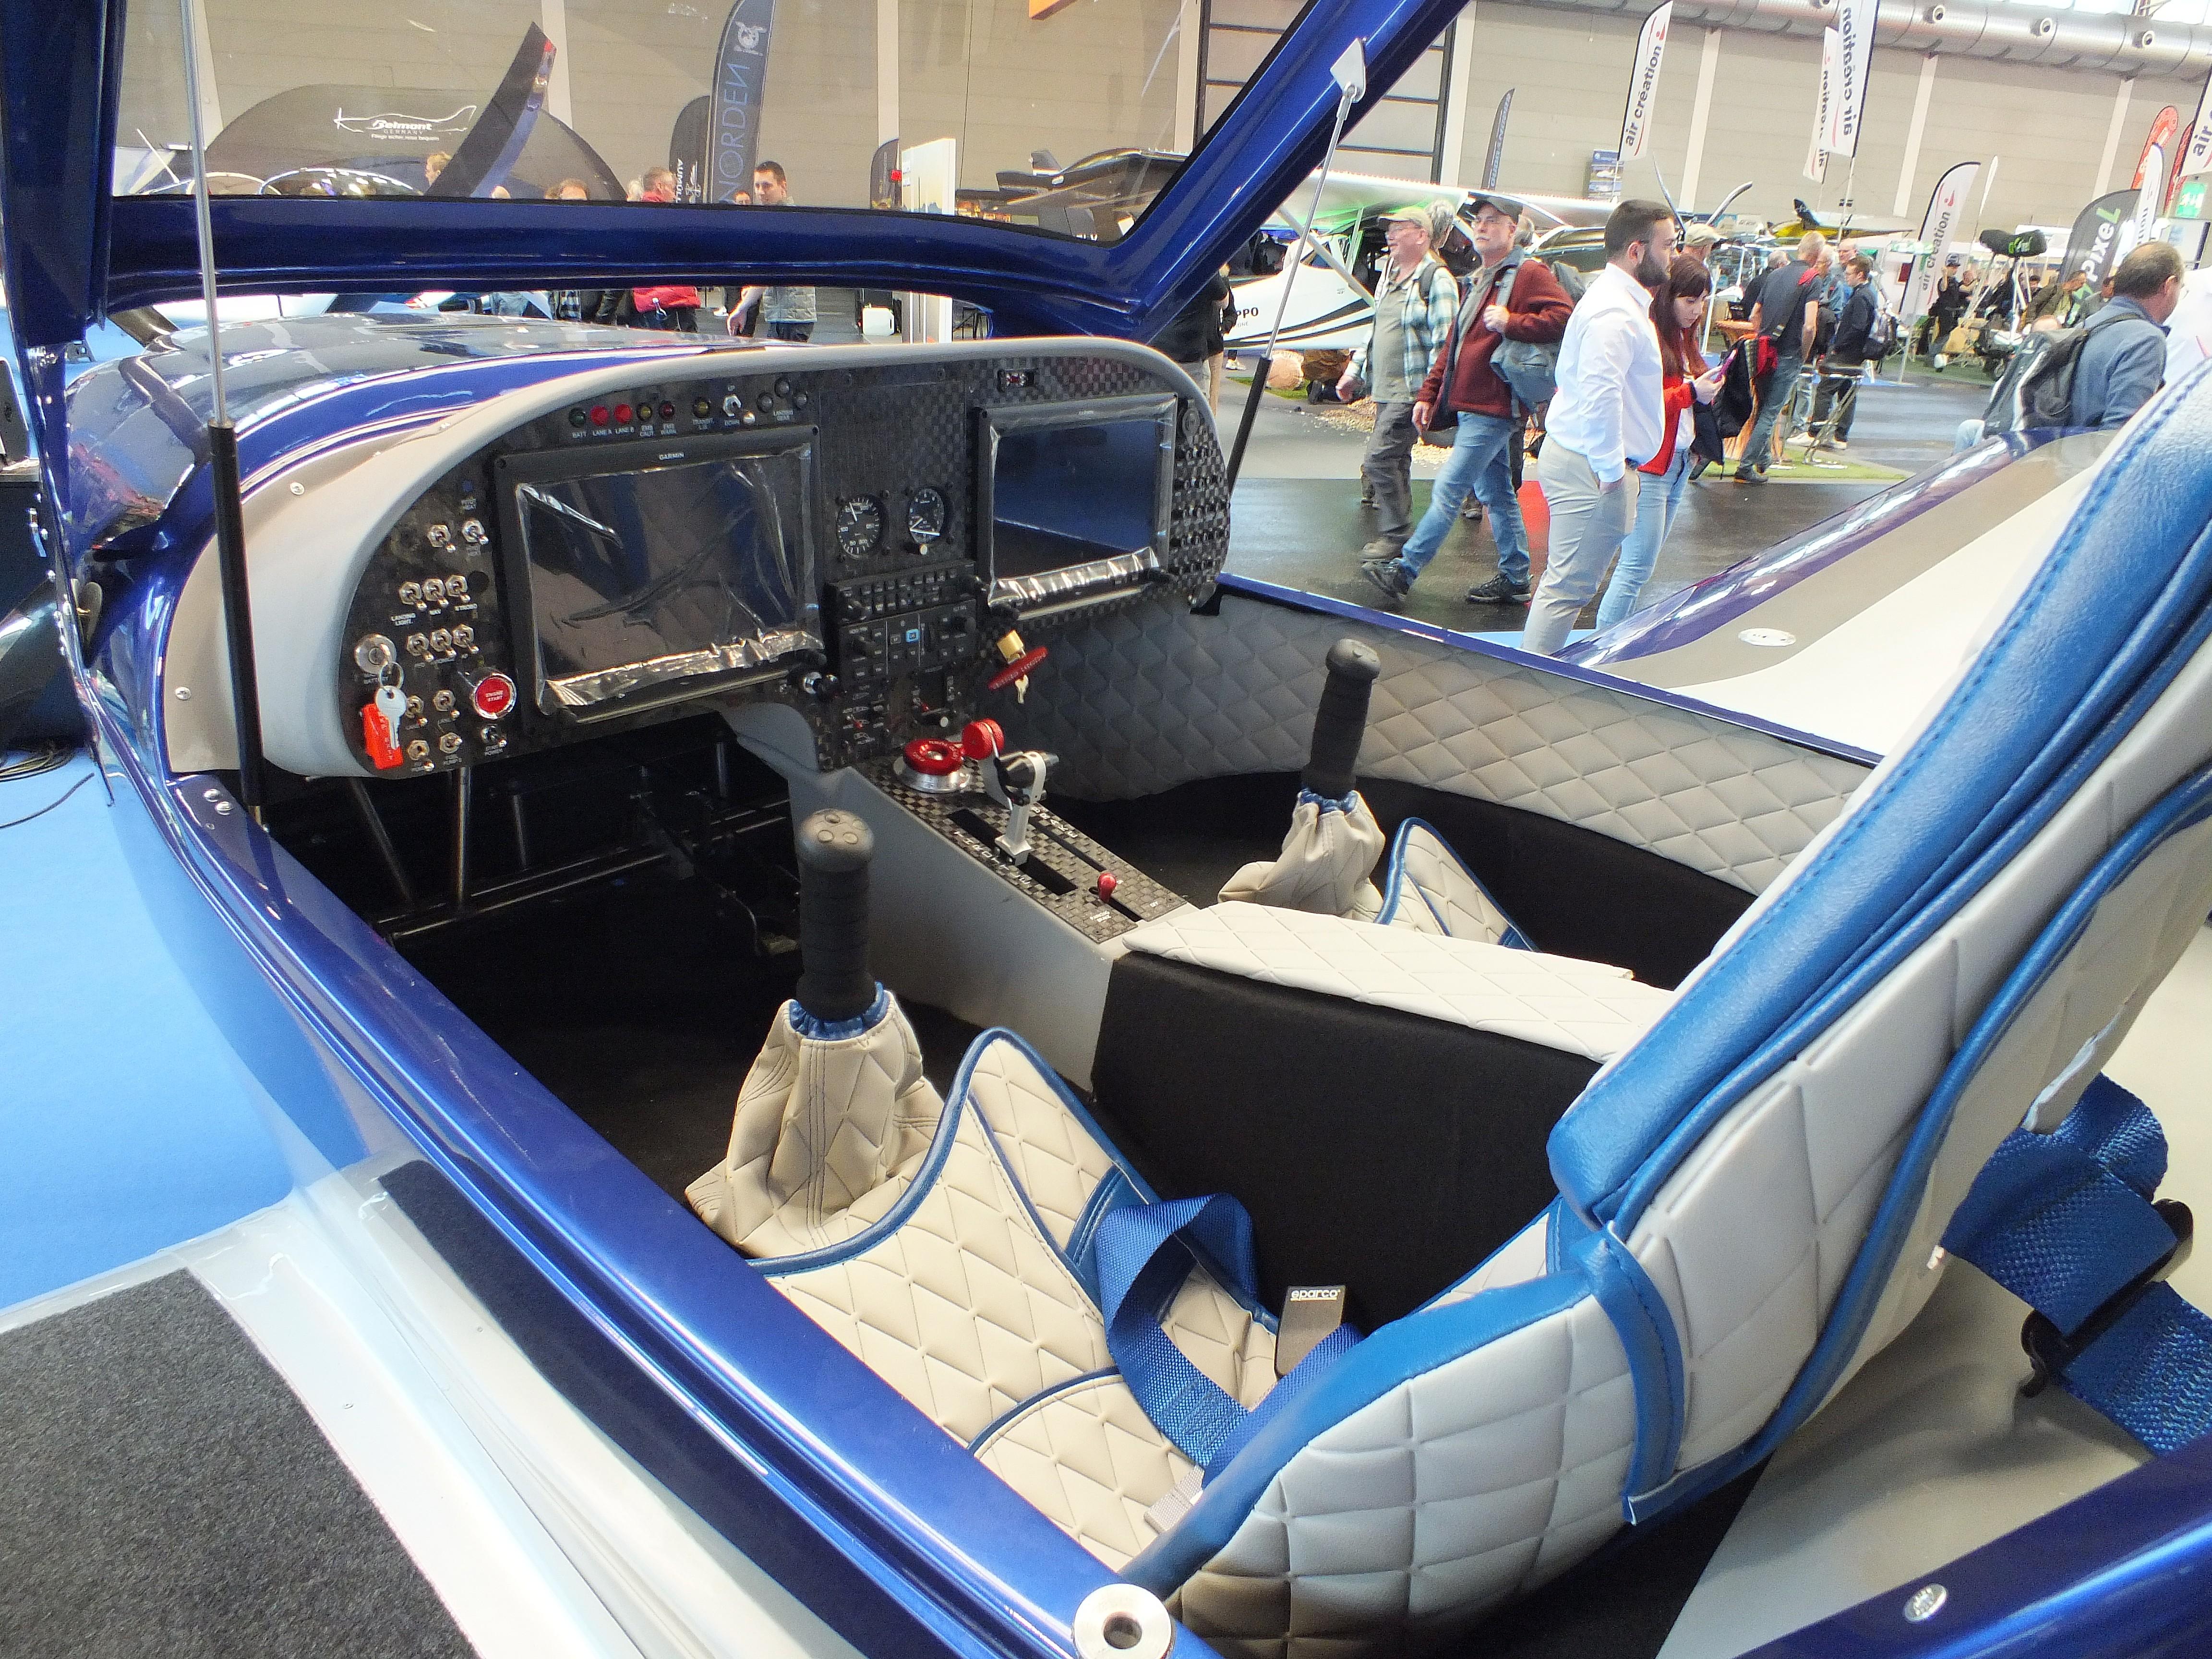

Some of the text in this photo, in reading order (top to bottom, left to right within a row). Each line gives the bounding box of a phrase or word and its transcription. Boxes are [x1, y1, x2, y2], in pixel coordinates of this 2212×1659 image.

[1625, 123, 1638, 146] air
[2192, 125, 2211, 157] air
[1032, 806, 1078, 839] BRAKE
[954, 830, 1030, 885] THROTTLE
